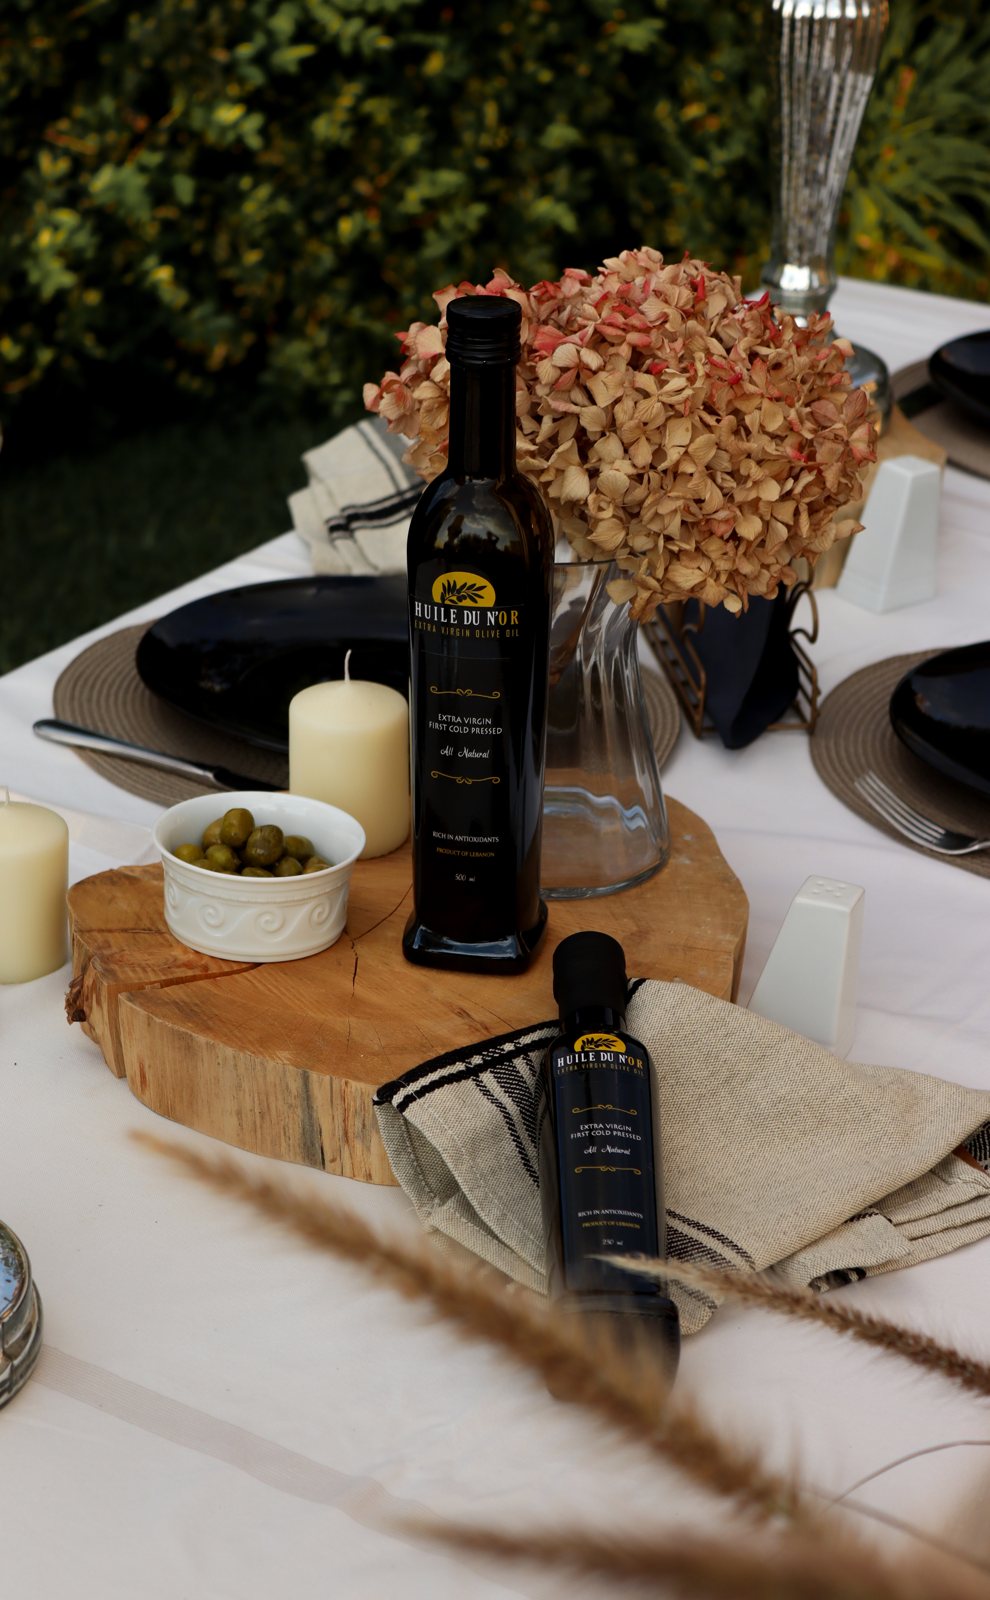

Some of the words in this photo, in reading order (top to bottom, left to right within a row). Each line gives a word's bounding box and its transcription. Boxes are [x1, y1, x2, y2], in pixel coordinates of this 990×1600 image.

[415, 601, 458, 624] HUILE
[464, 610, 480, 625] DU
[414, 620, 436, 632] EXTRA
[441, 628, 470, 638] VIRGIN
[476, 630, 500, 638] OLIVE
[506, 629, 519, 638] OIL
[438, 714, 462, 723] EXTRA
[429, 721, 447, 730] FIRST
[448, 725, 469, 734] COLD
[440, 746, 454, 756] All
[458, 747, 490, 758] Natural
[432, 831, 446, 839] RICH
[436, 847, 460, 856] PRODUCT
[558, 1052, 595, 1068] HUILE
[600, 1052, 614, 1062] DU
[605, 1123, 632, 1132] VIRGIN
[571, 1131, 589, 1140] FIRST
[613, 1131, 642, 1141] PRESSED
[584, 1146, 596, 1155] All
[601, 1144, 631, 1155] Natural
[601, 1209, 643, 1219] ANTIOXIDANTS
